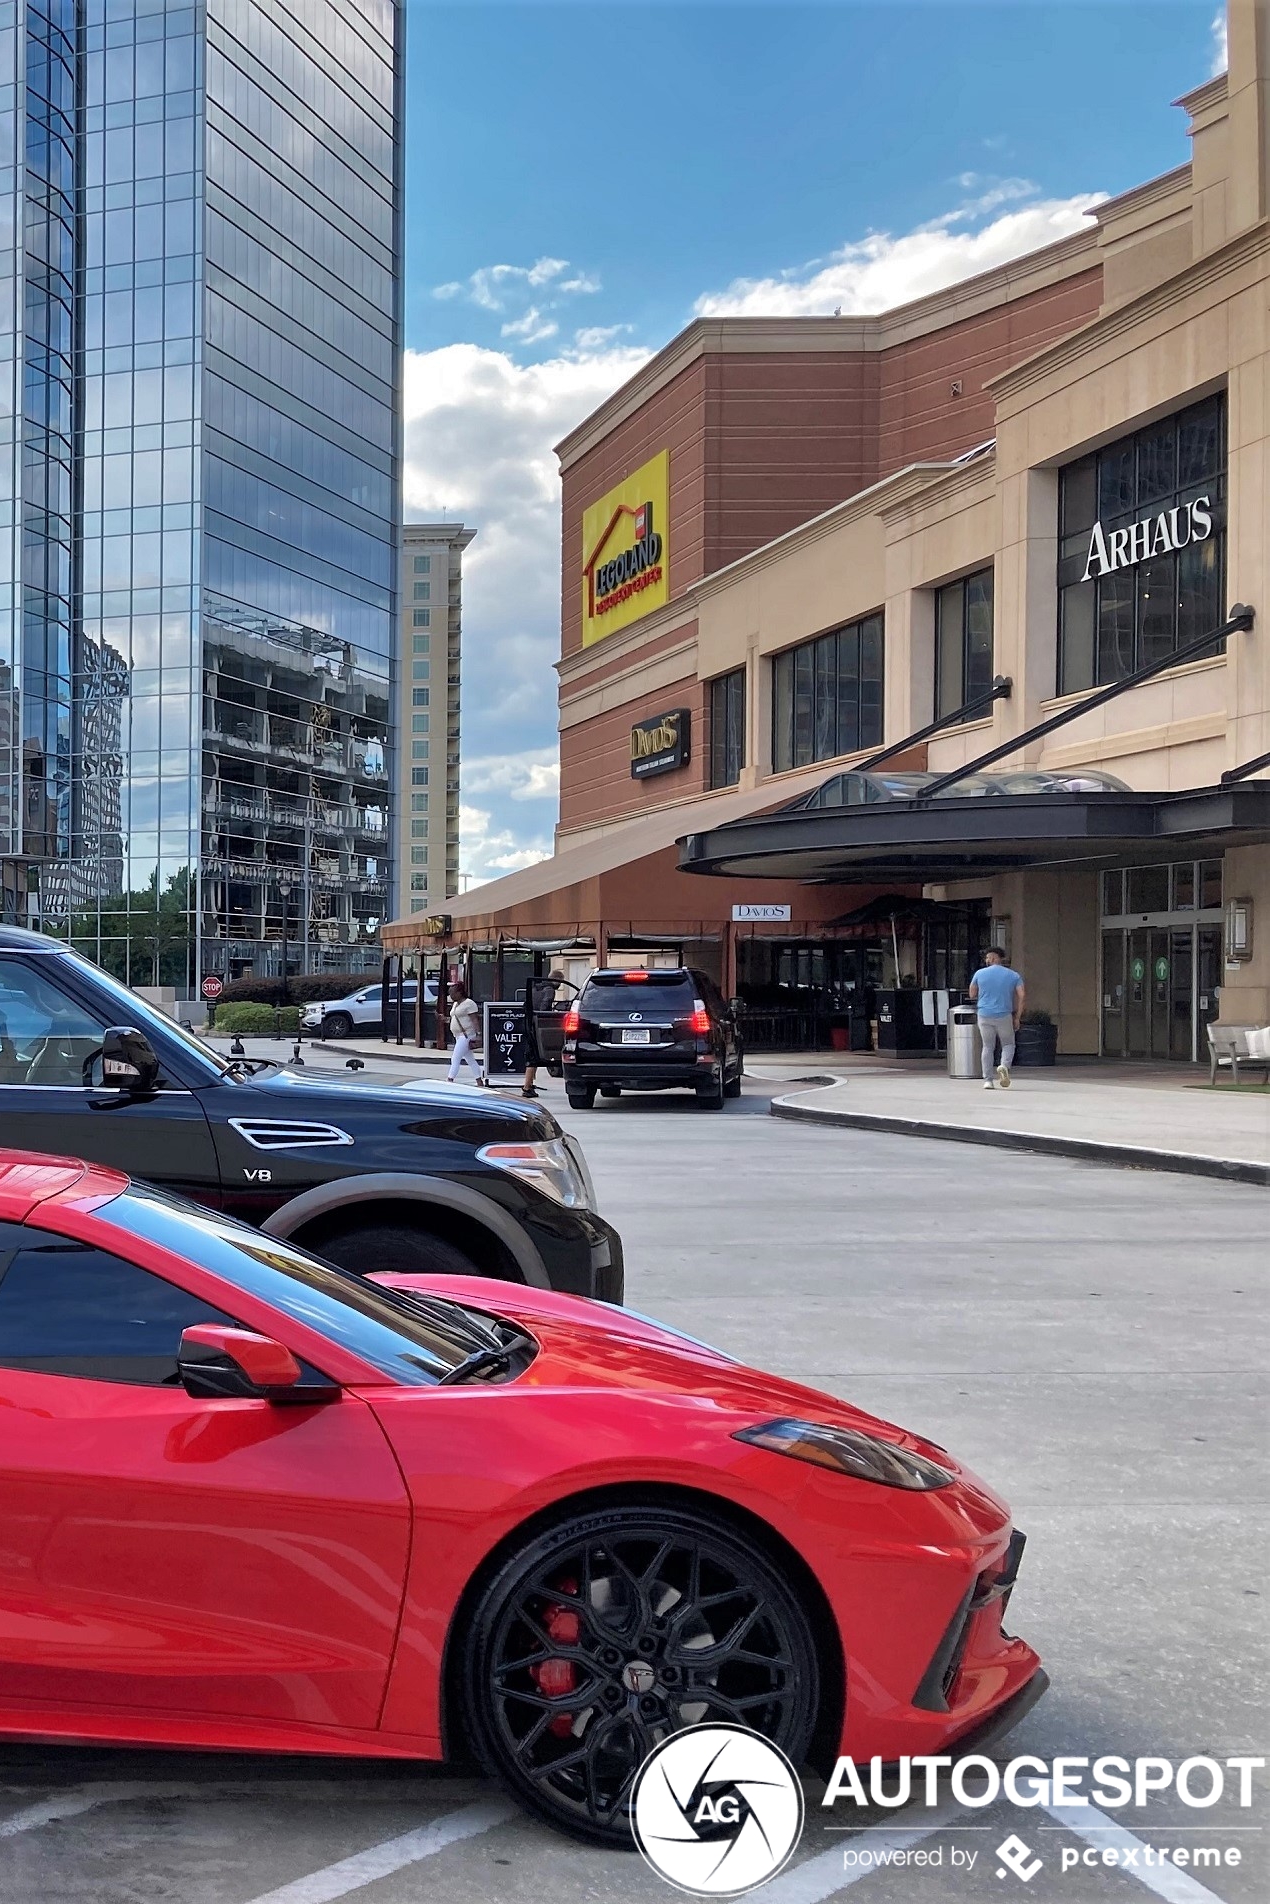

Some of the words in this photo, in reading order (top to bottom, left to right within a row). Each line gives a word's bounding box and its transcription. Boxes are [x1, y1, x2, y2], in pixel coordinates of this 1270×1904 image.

[1081, 495, 1212, 582] ARHAUS
[596, 532, 662, 597] LEGOLAND
[203, 983, 221, 991] STOP
[494, 1033, 523, 1042] VALET
[499, 1044, 514, 1055] $7
[243, 1168, 272, 1181] V8
